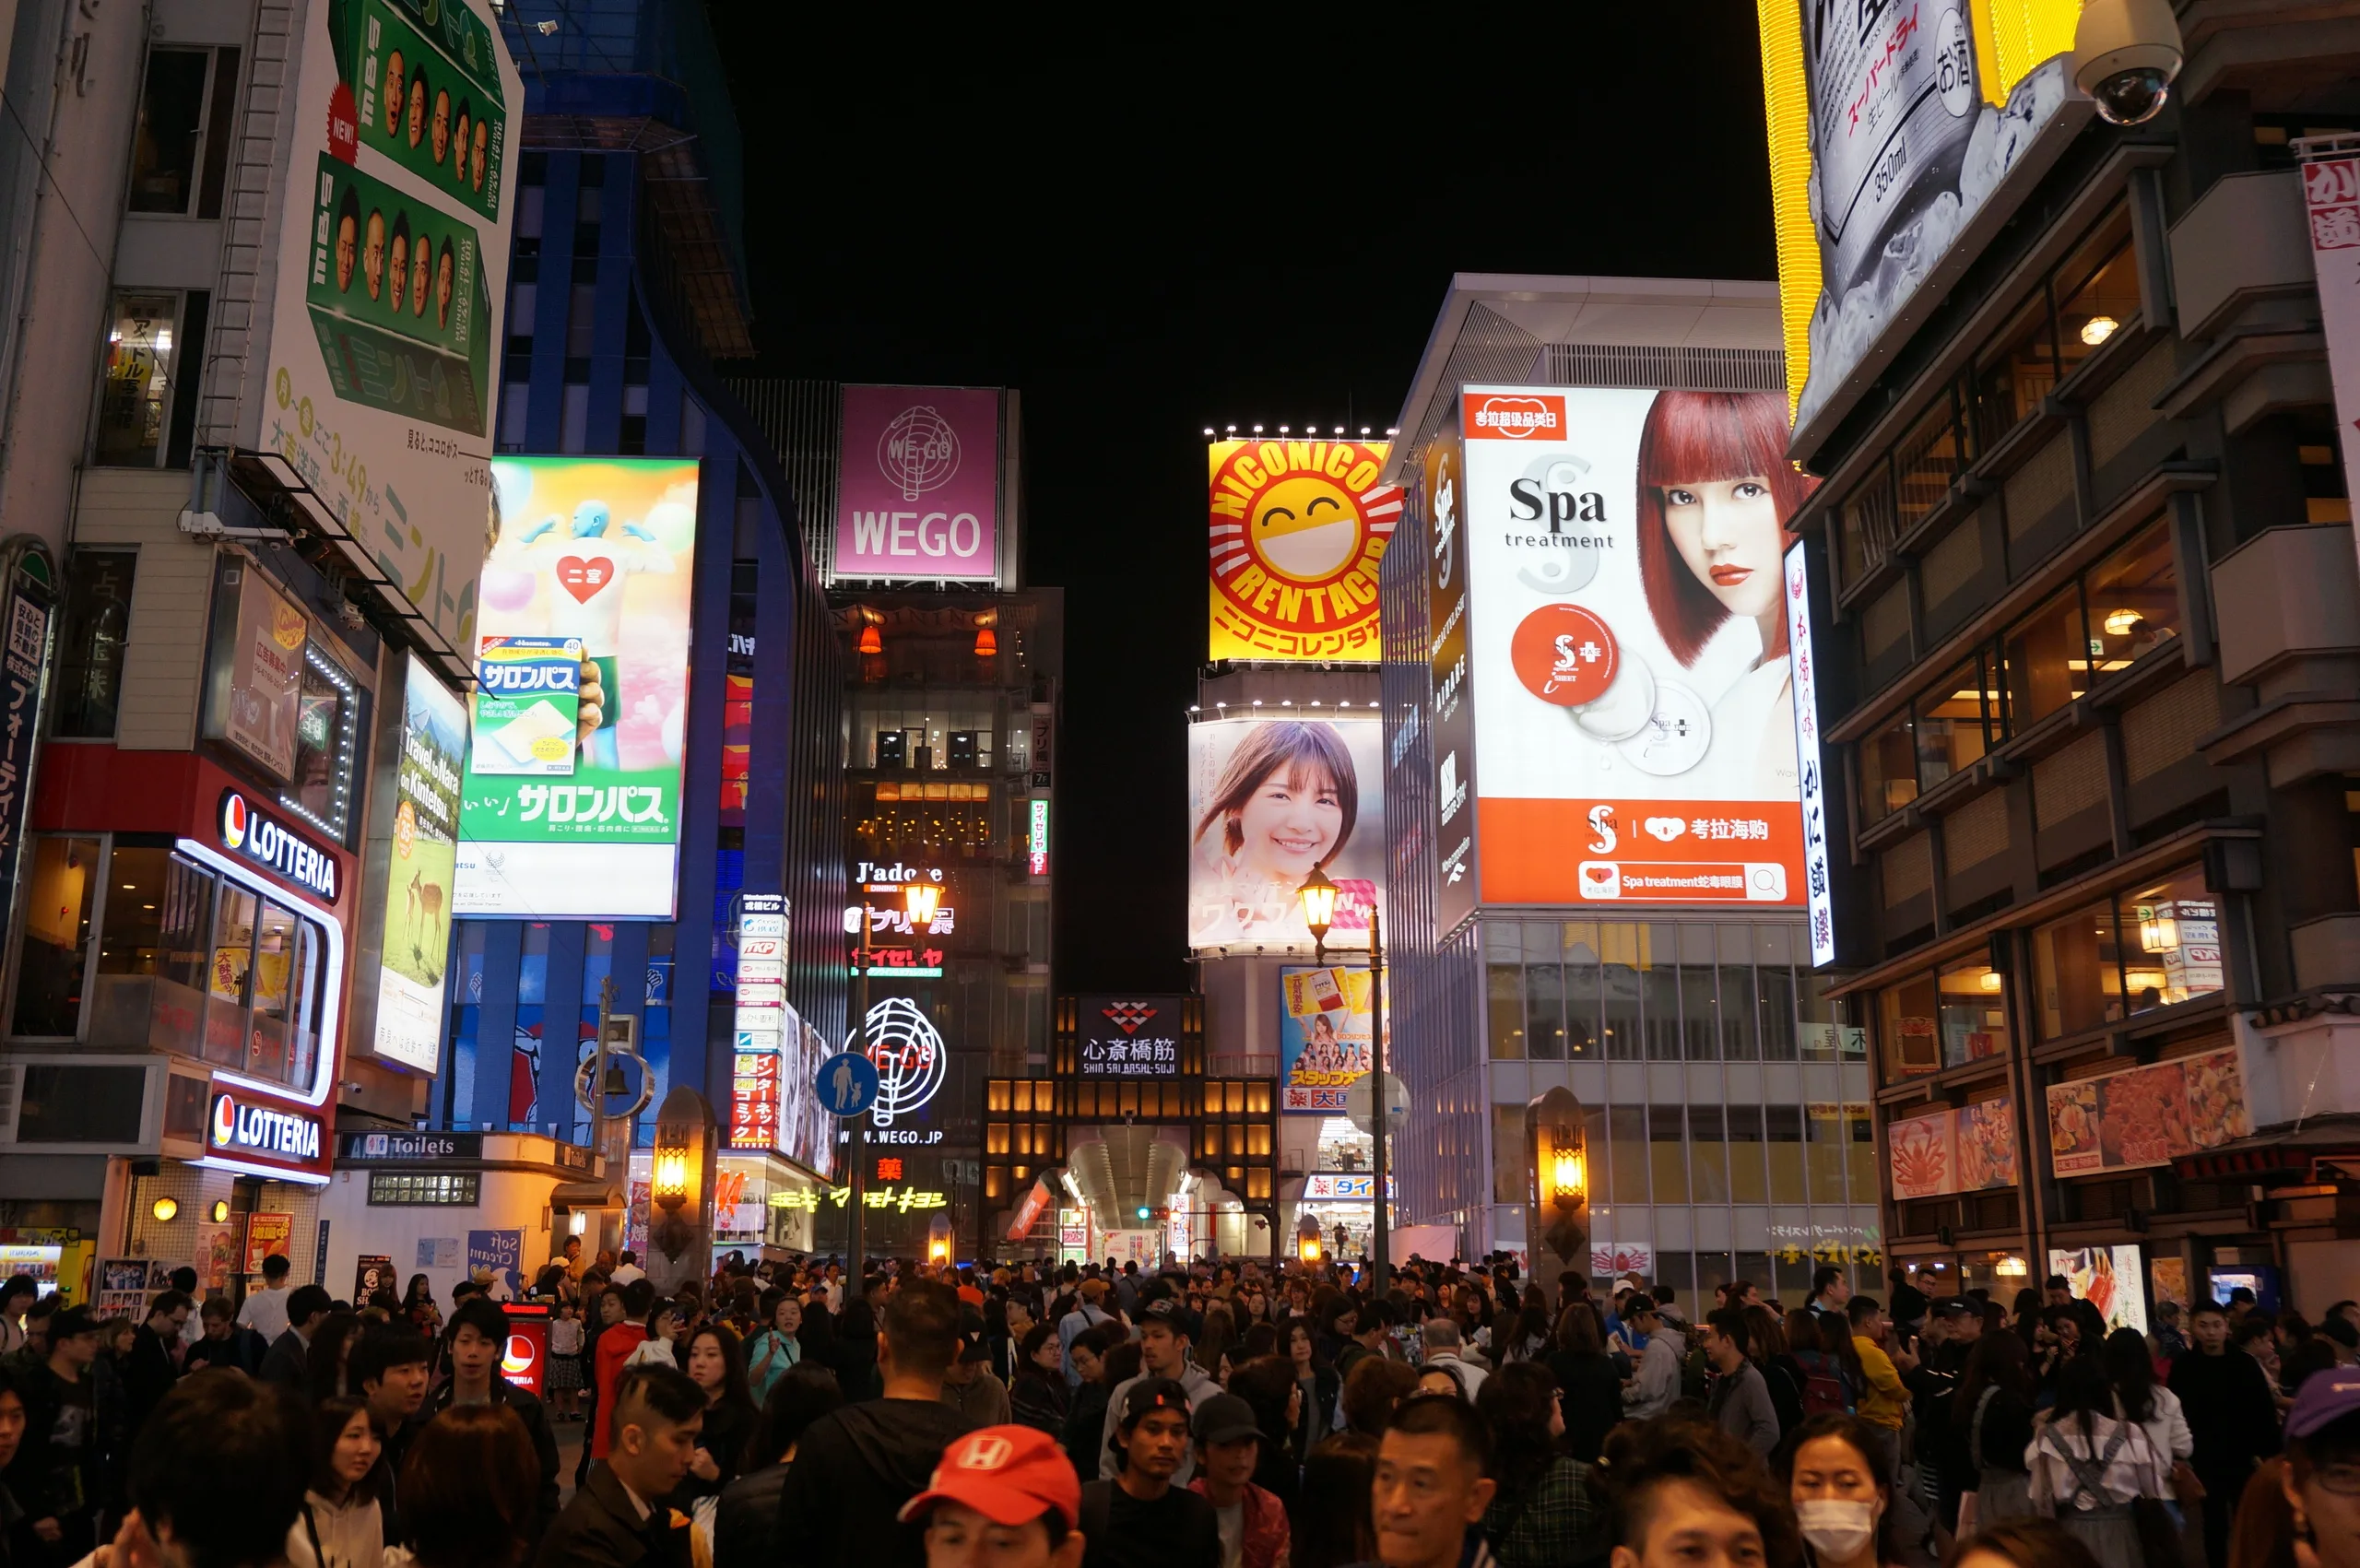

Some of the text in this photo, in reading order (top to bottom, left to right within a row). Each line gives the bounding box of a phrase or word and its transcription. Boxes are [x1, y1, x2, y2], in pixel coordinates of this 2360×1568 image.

[1847, 2, 1918, 138] スーパードライ
[1937, 39, 1972, 95] お酒
[1866, 71, 1901, 136] 生ビール
[333, 116, 355, 146] NEW!
[1874, 135, 1907, 204] 350ml
[1475, 410, 1557, 428] 考拉超级品类日
[1210, 441, 1379, 520] NICONICO
[1510, 477, 1608, 534] Spa
[853, 511, 981, 558] WEGO
[1504, 532, 1615, 548] treatment
[567, 568, 602, 584] 二宮
[867, 608, 991, 628] DINING
[566, 641, 580, 651] 40
[256, 642, 288, 678] 広告募集中
[484, 665, 575, 690] サロンパス
[1436, 653, 1466, 713] AIRARE
[406, 726, 459, 796] Travel to Nara
[1035, 773, 1048, 783] 7F
[400, 770, 449, 823] on Kintetsu.
[517, 784, 663, 824] サロンパス
[1033, 804, 1044, 848] サイゼリヤ
[1691, 819, 1769, 841] 考拉海购
[250, 812, 335, 898] LOTTERIA
[1032, 854, 1044, 874] 6F
[856, 862, 943, 884] J'adoe
[1622, 875, 1644, 890] Spa
[746, 941, 775, 954] TKP
[1292, 975, 1303, 1014] 元気激安
[1082, 1037, 1176, 1062] 心斎橋筋
[1083, 1063, 1104, 1074] SHIN
[1106, 1063, 1121, 1074] SAI
[1291, 1069, 1372, 1086] スタッフ大
[755, 1055, 773, 1138] インターネット
[1289, 1090, 1308, 1107] 薬
[734, 1091, 752, 1138] コミック
[237, 1104, 320, 1158] LOTTERIA
[840, 1130, 944, 1145] WW.WEGO.JP
[392, 1137, 454, 1154] Toilets
[878, 1158, 903, 1181] 薬
[1314, 1174, 1330, 1196] 薬
[830, 1185, 948, 1213] マモトキヨシ
[252, 1226, 289, 1240] 増量中
